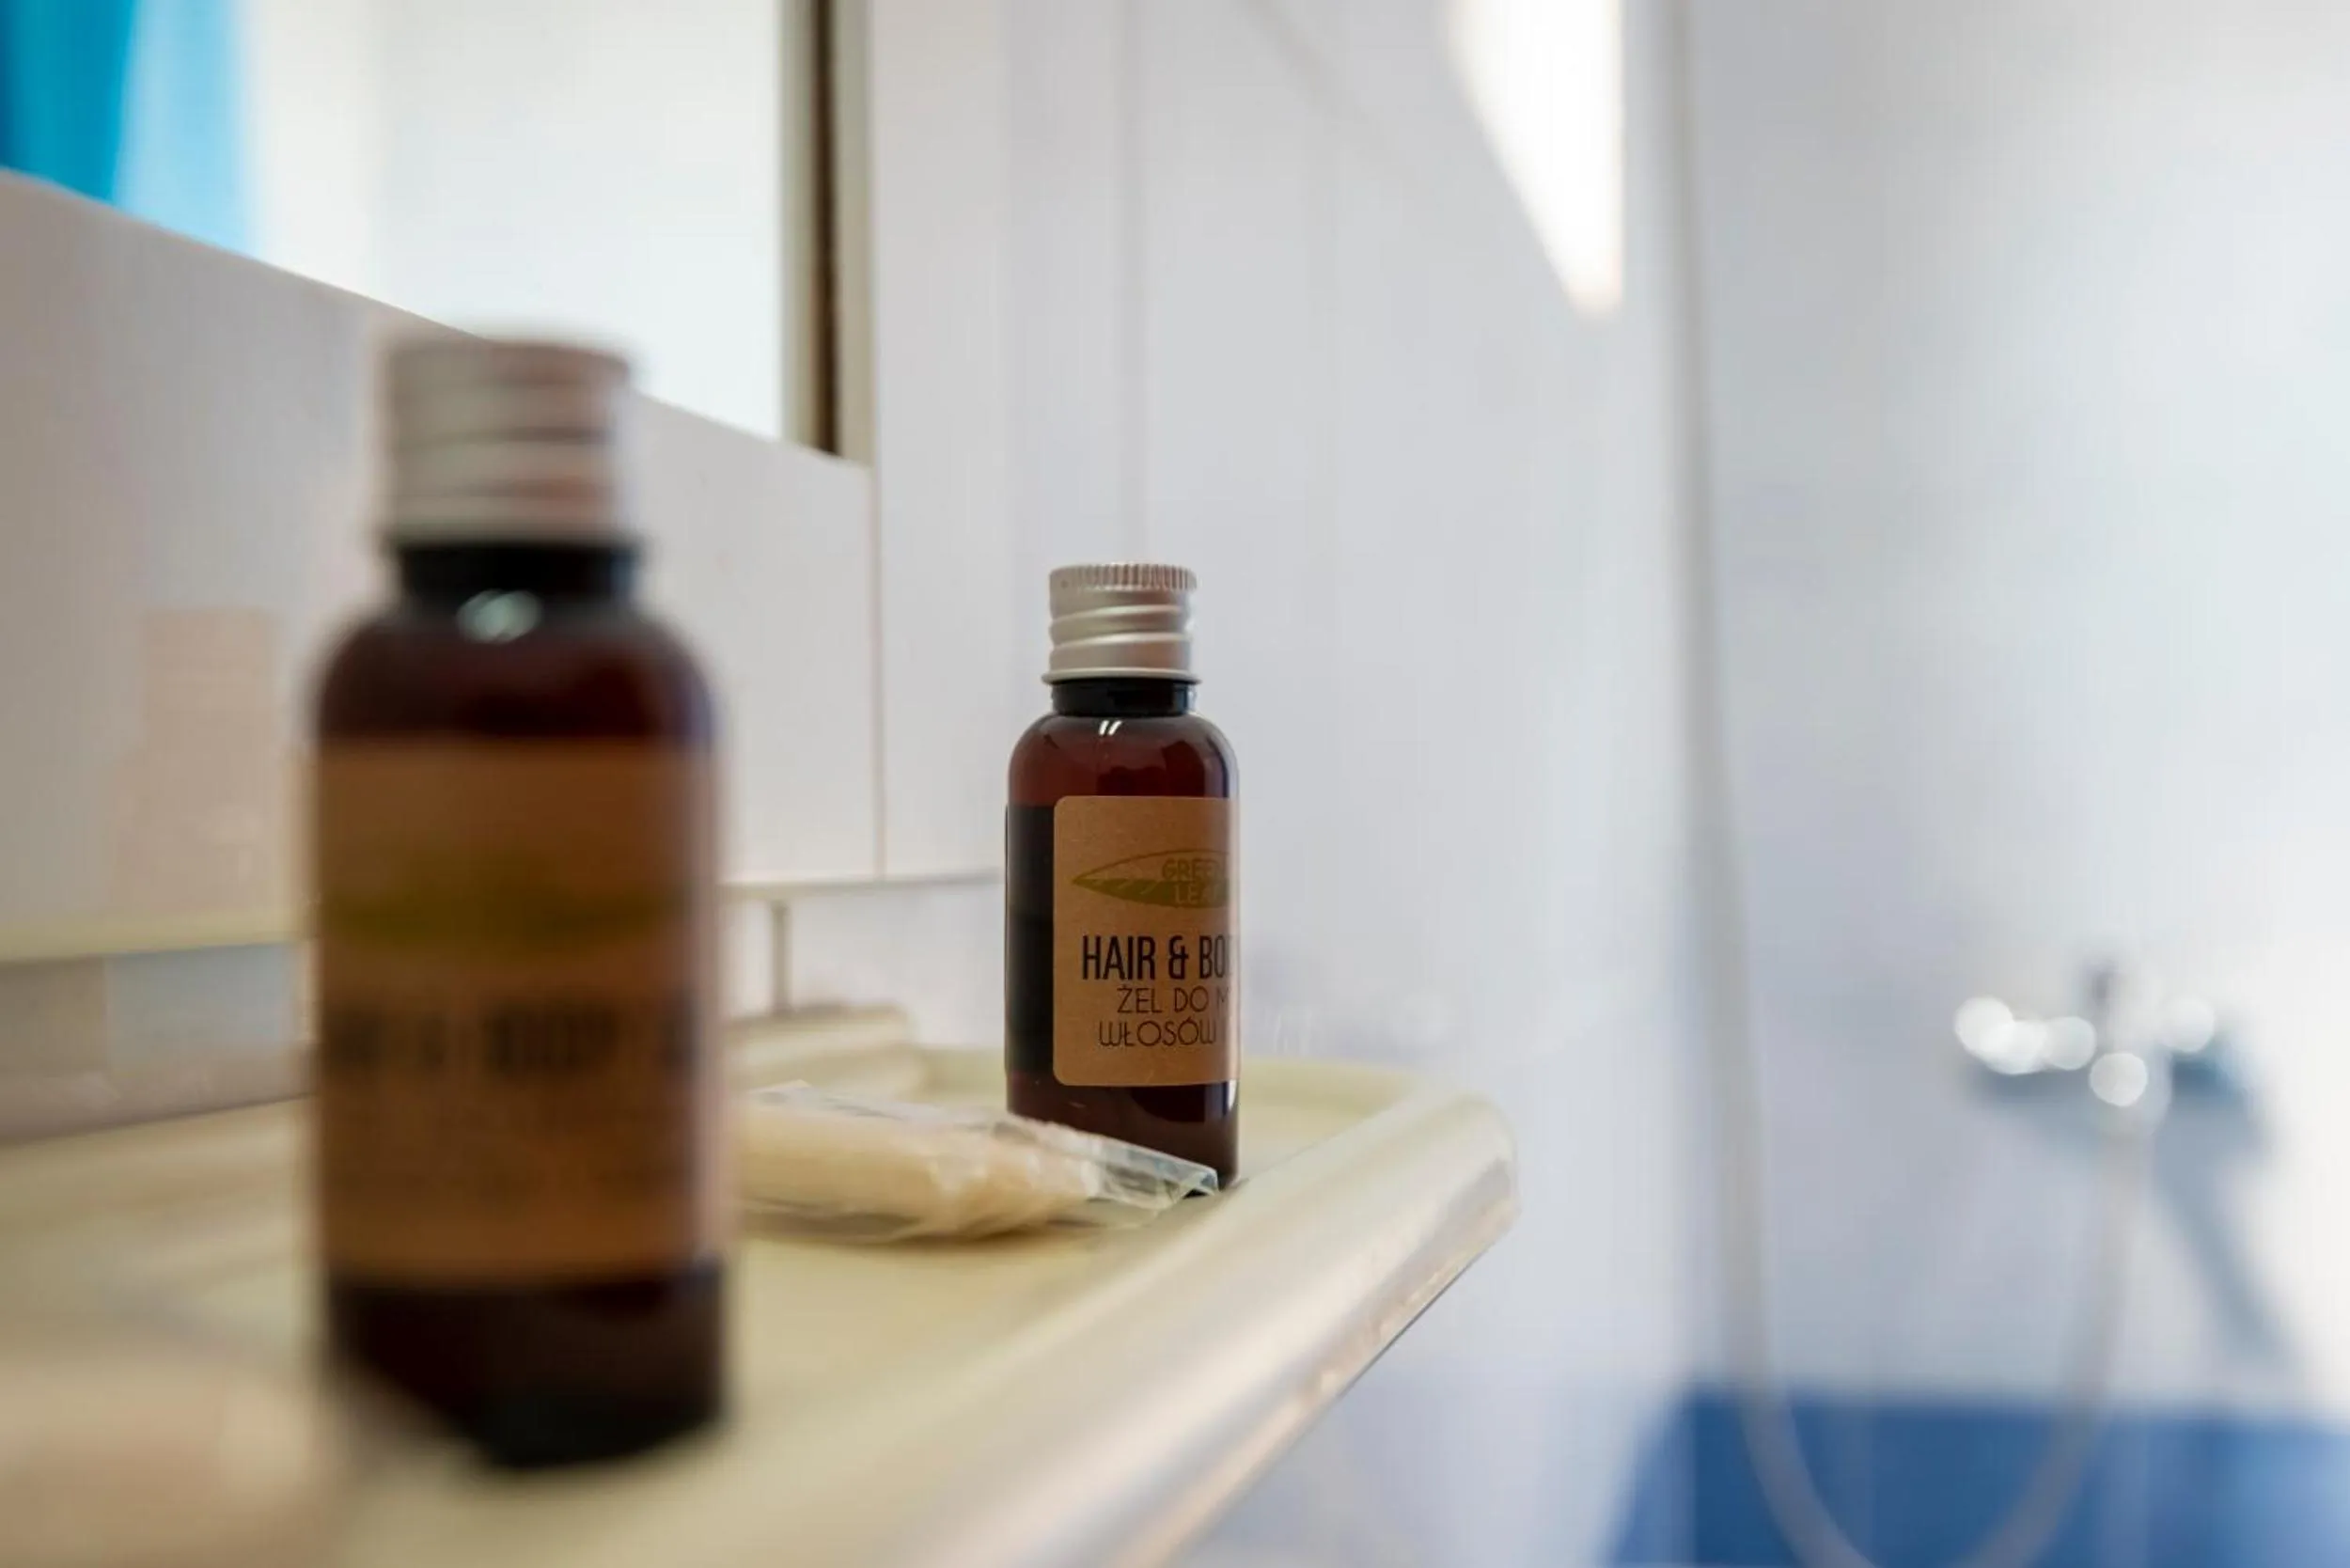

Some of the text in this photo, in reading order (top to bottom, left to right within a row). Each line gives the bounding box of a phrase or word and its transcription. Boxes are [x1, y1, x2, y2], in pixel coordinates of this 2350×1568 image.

[1082, 935, 1156, 980] HAIR
[1168, 934, 1189, 980] &
[1117, 984, 1163, 1014] ŻEL
[1174, 985, 1210, 1013] DO
[1099, 1015, 1217, 1047] WŁOSÓW
